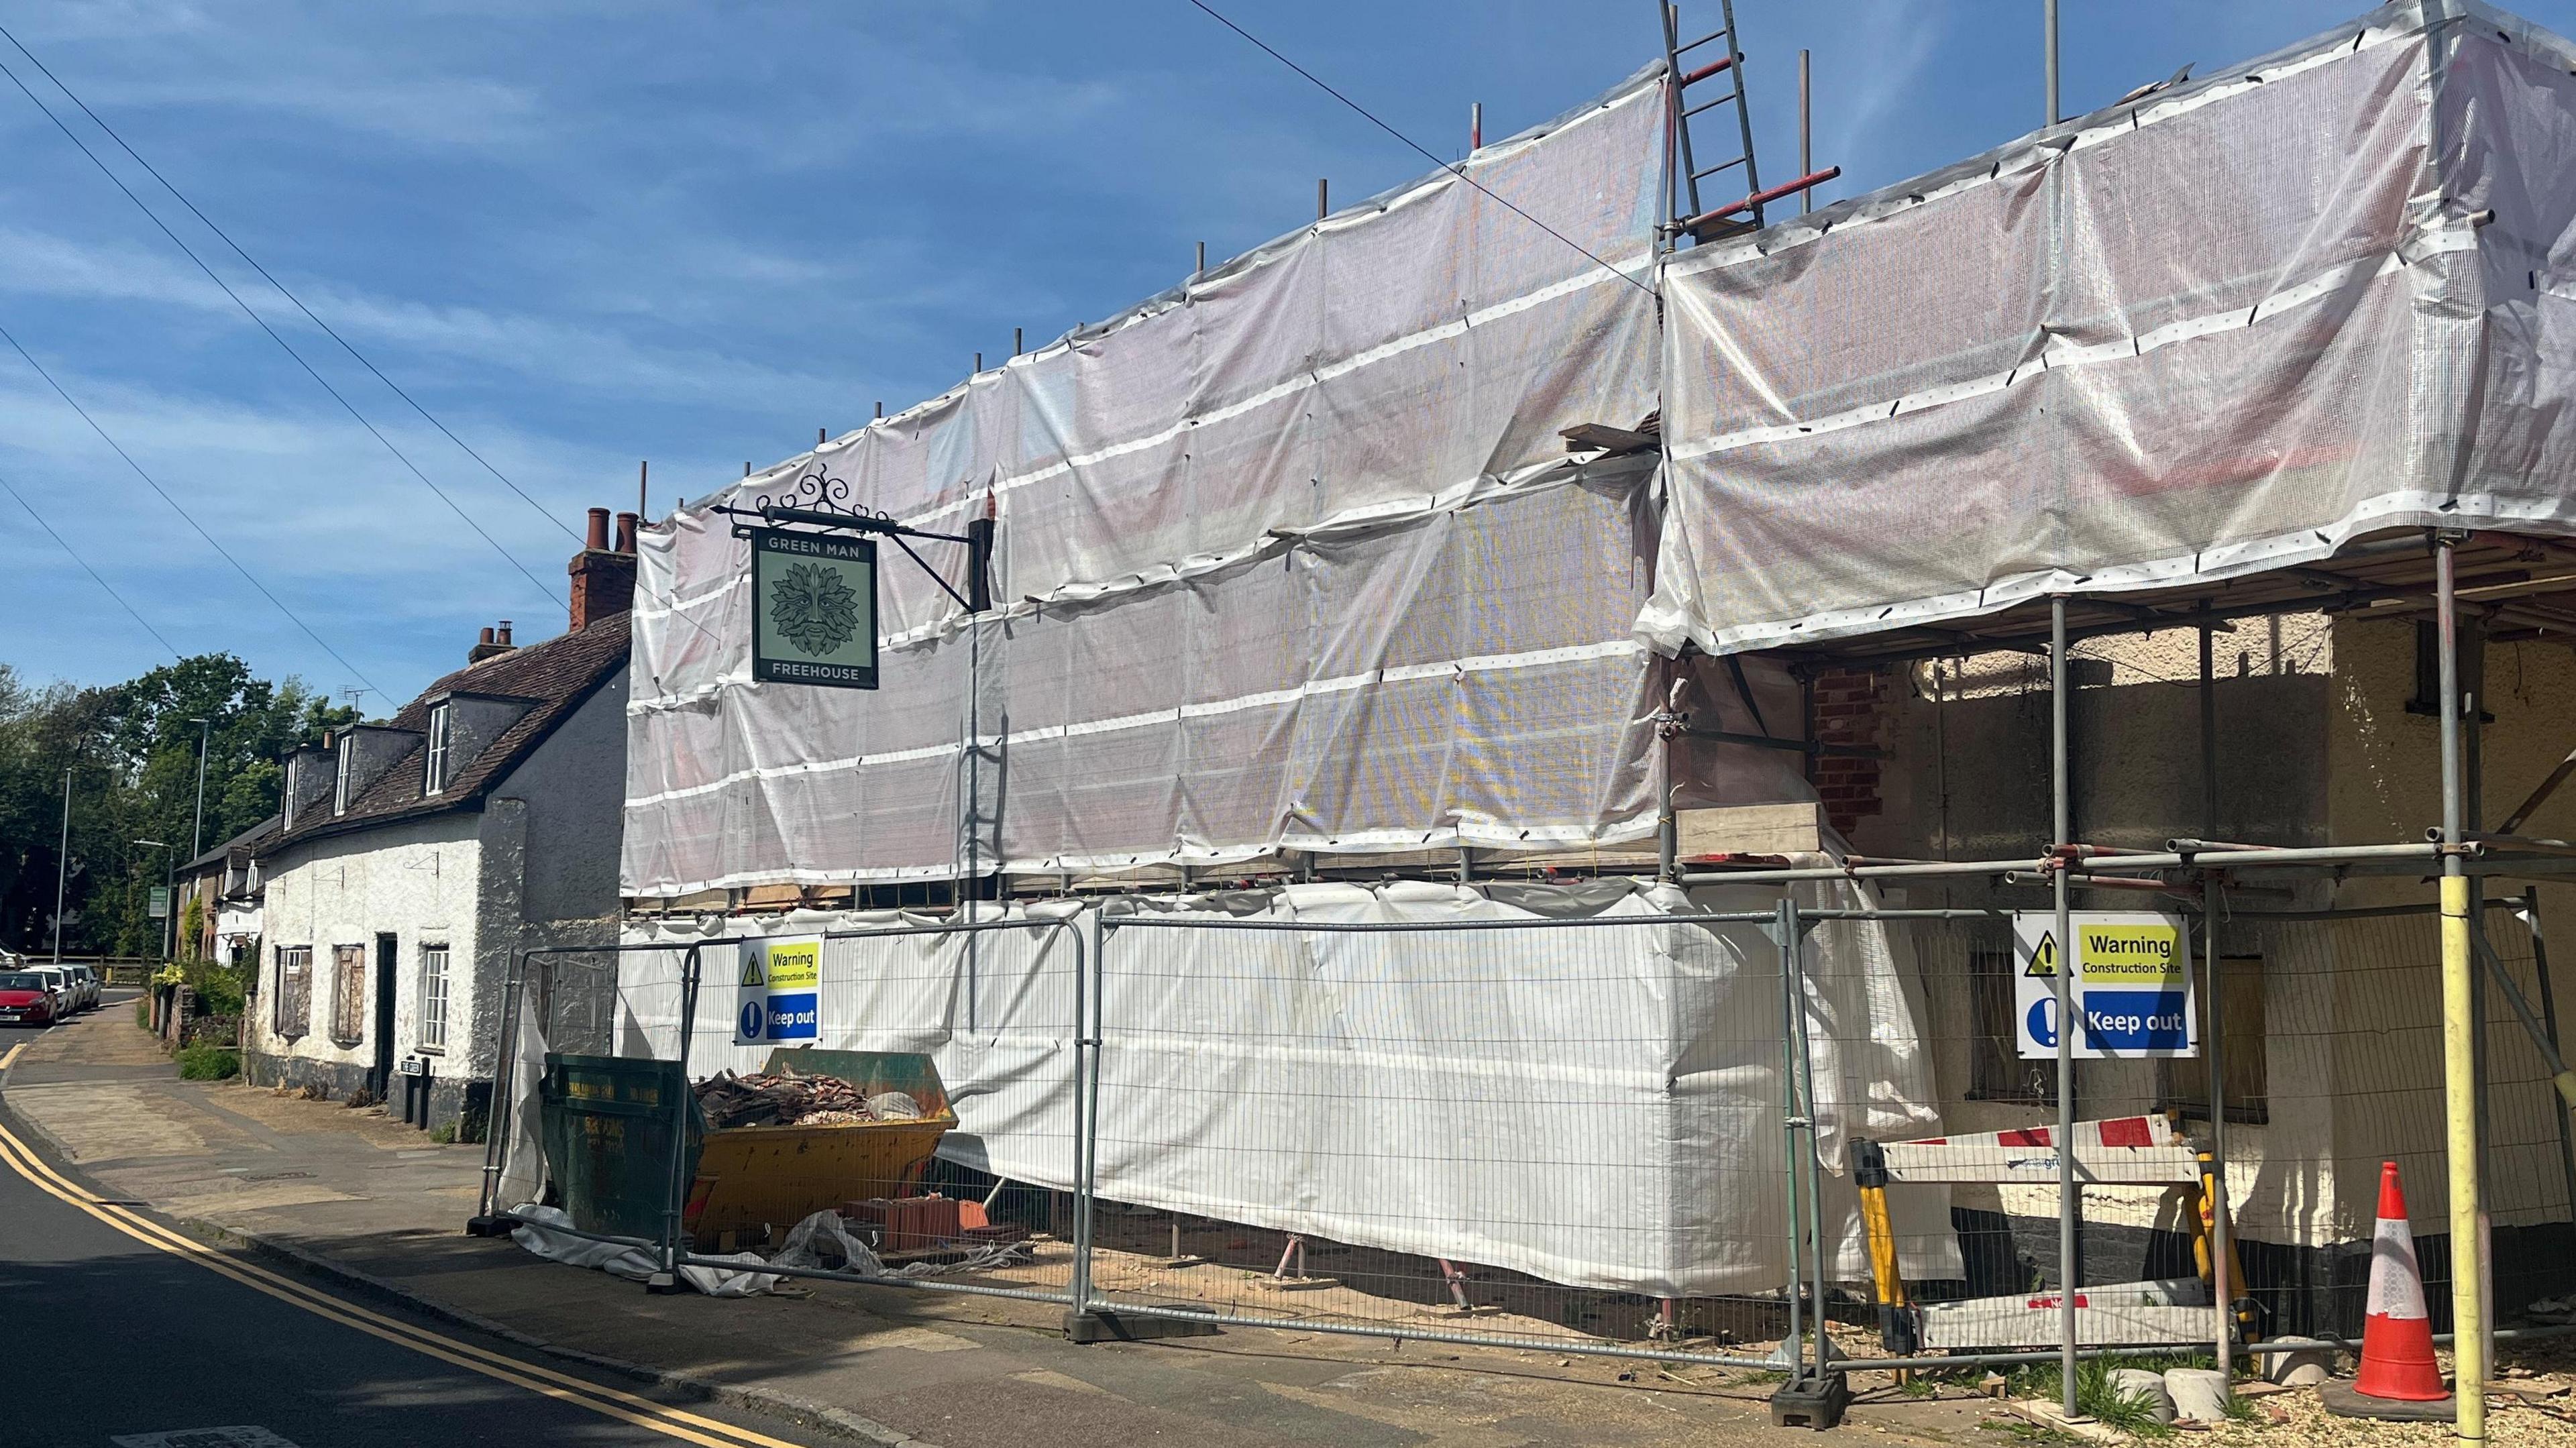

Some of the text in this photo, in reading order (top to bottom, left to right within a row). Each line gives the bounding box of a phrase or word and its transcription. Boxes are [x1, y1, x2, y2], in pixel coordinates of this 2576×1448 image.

[768, 537, 859, 558] GREEN MAN
[772, 663, 859, 680] FREEHOUSE
[2089, 936, 2171, 958] Warning
[773, 952, 814, 968] Warning
[2082, 962, 2181, 974] Construction Site
[768, 971, 817, 983] Construction Site
[768, 1009, 814, 1027] Keep out
[2088, 1011, 2182, 1035] Keep out
